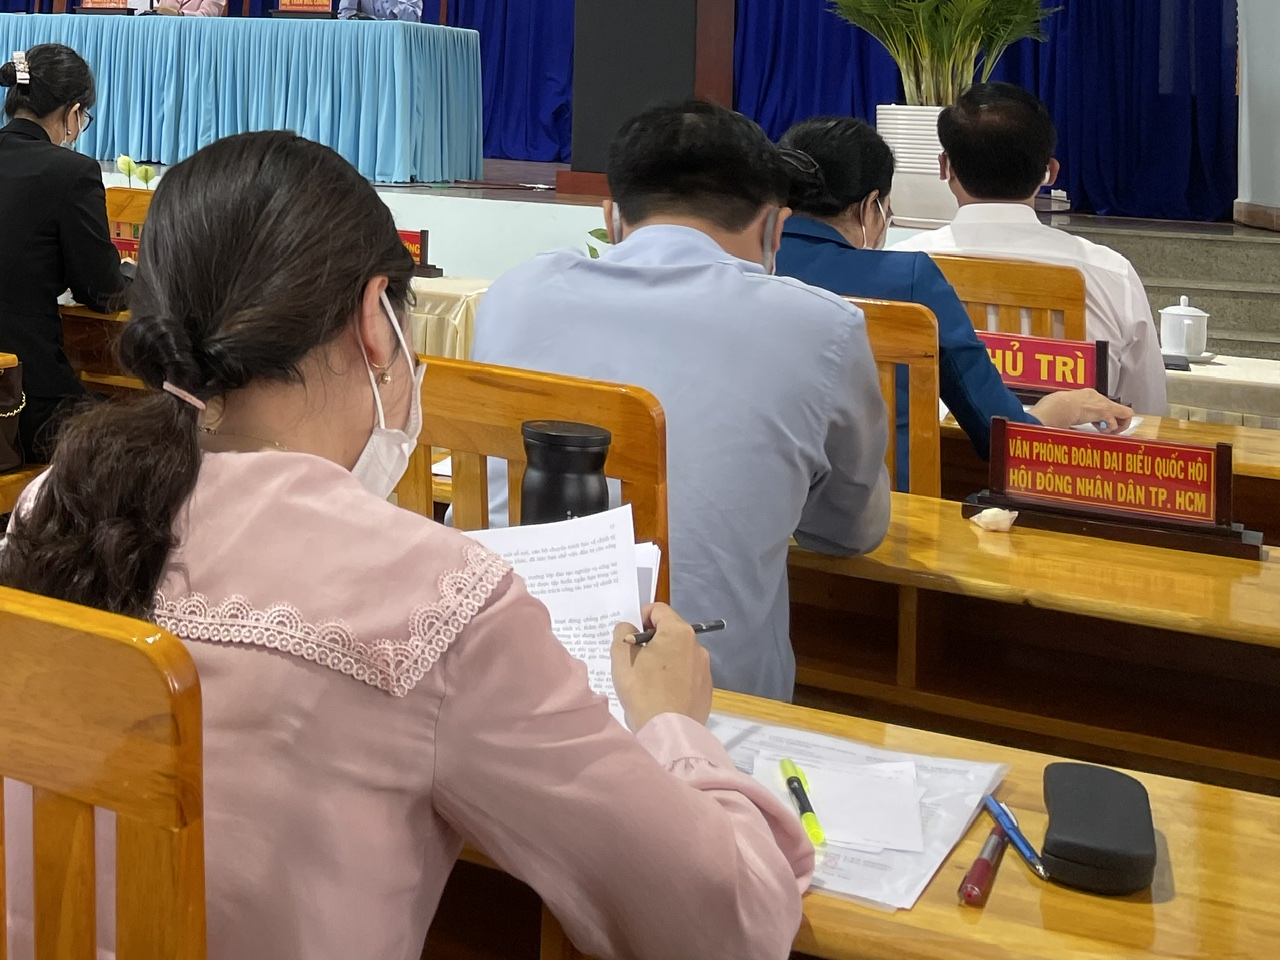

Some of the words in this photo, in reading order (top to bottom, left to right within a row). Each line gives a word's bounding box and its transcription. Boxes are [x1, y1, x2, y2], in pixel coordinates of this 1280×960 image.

[1035, 351, 1085, 385] TRÌ
[1009, 438, 1029, 461] VĂN
[1033, 439, 1068, 466] PHÒNG
[1072, 445, 1100, 469] ĐOÀN
[1104, 449, 1122, 475] ĐẠI
[1126, 445, 1151, 475] BIỂU
[1155, 452, 1185, 480] QUỐC
[1188, 457, 1207, 485] HỘI
[1009, 465, 1032, 491] HỘI
[1036, 469, 1072, 495] ĐỒNG
[1076, 475, 1113, 500] NHÂN
[1117, 480, 1146, 504] DÂN
[1150, 486, 1171, 509] TP.
[1175, 489, 1207, 514] HCM
